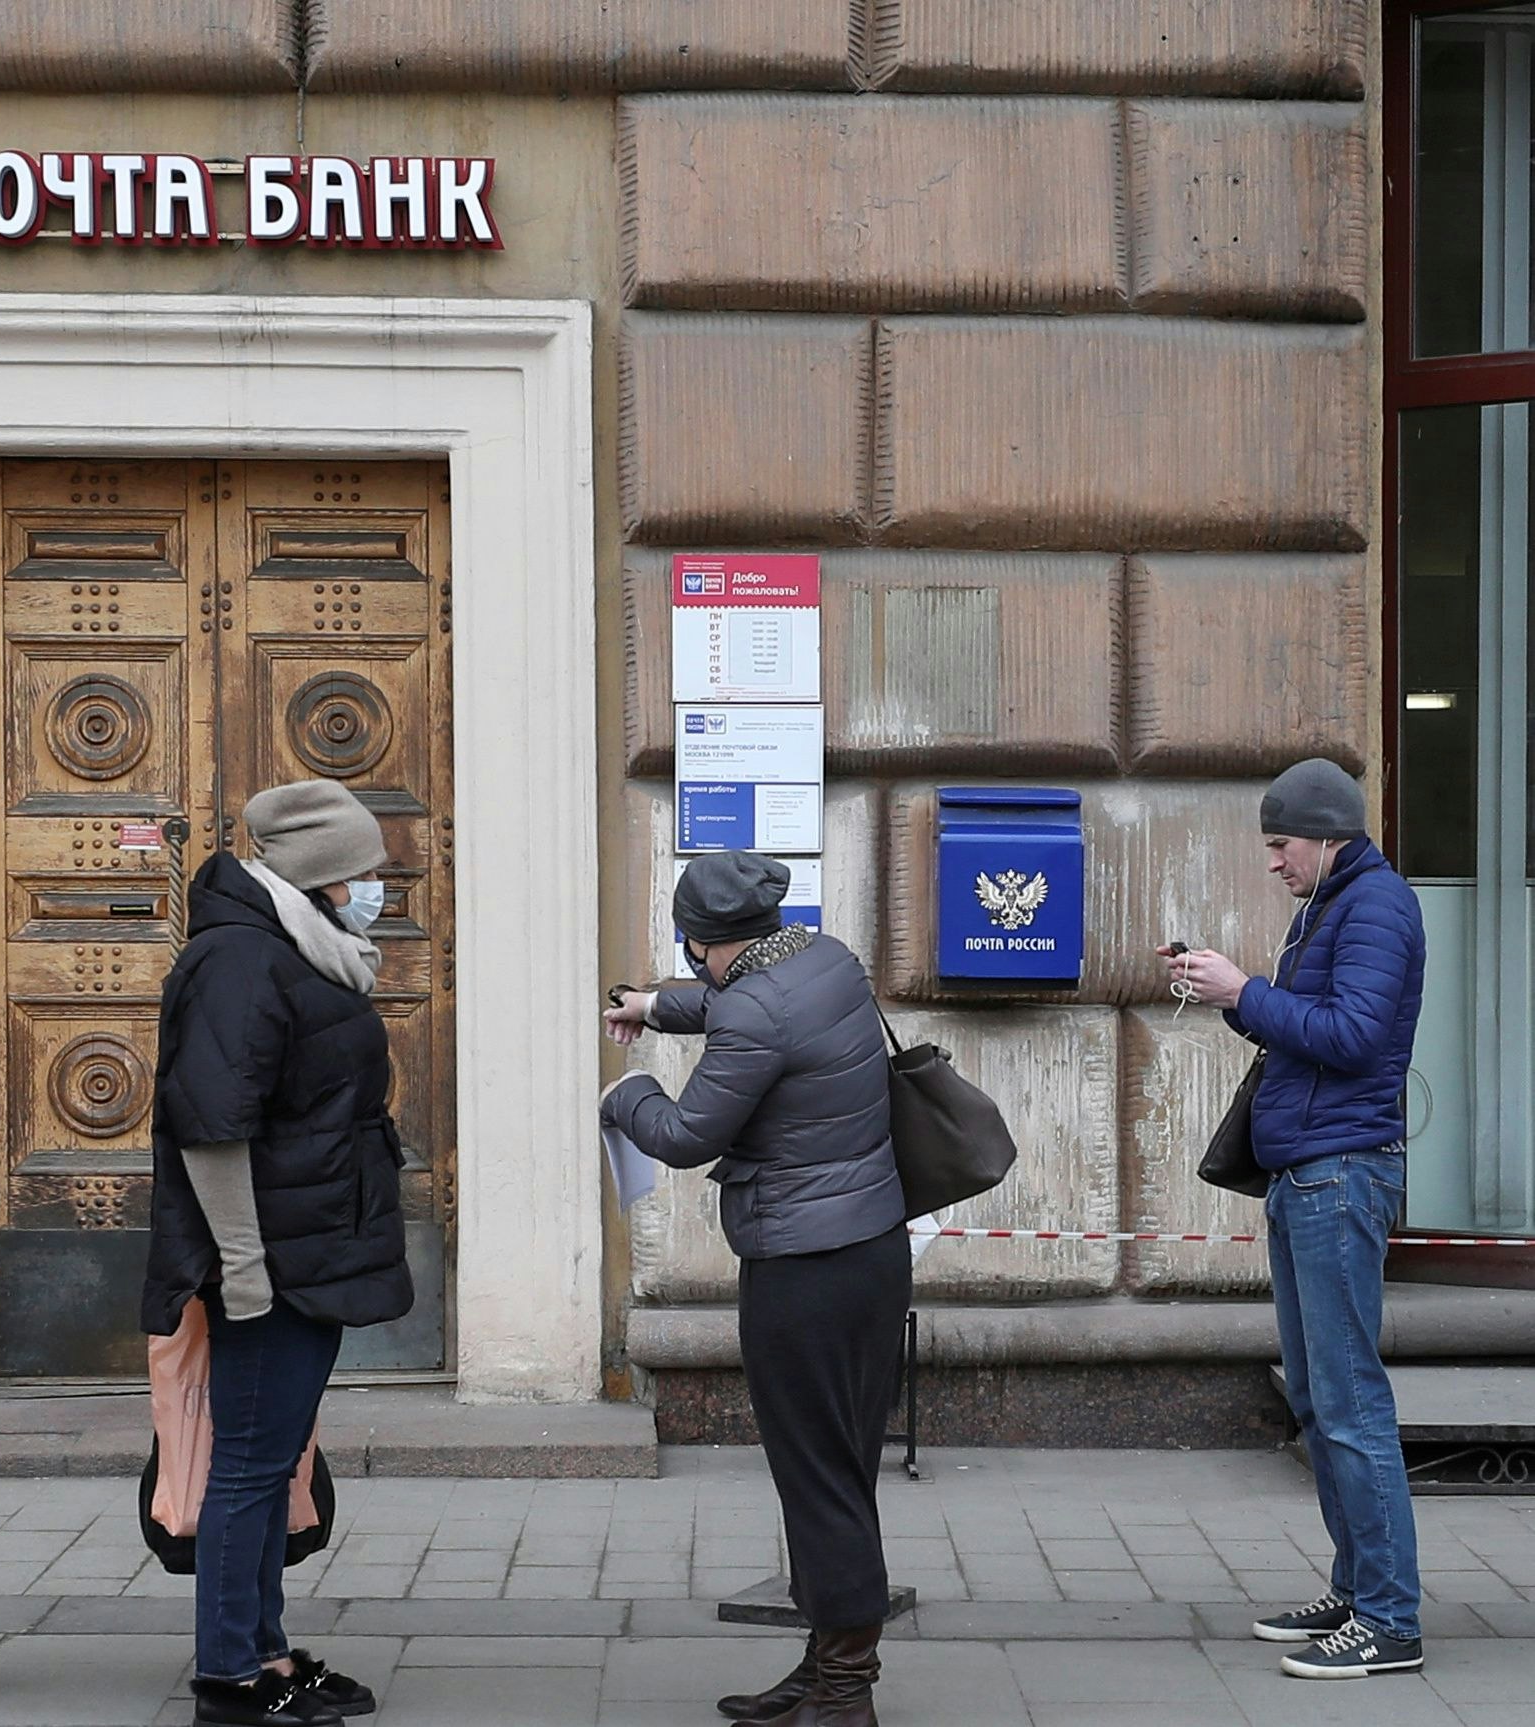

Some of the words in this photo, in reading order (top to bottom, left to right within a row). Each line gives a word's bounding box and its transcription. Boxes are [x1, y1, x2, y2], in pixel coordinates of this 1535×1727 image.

[250, 156, 493, 242] БАНК
[732, 572, 767, 584] Добро
[732, 586, 799, 596] пожаловать!
[709, 612, 722, 620] ПН
[709, 644, 721, 652] ЧТ
[709, 676, 721, 684] ВС
[684, 786, 708, 794] время
[708, 785, 737, 794] работы
[965, 937, 1004, 950] ПОЧТА
[1007, 938, 1055, 950] РОССИИ
